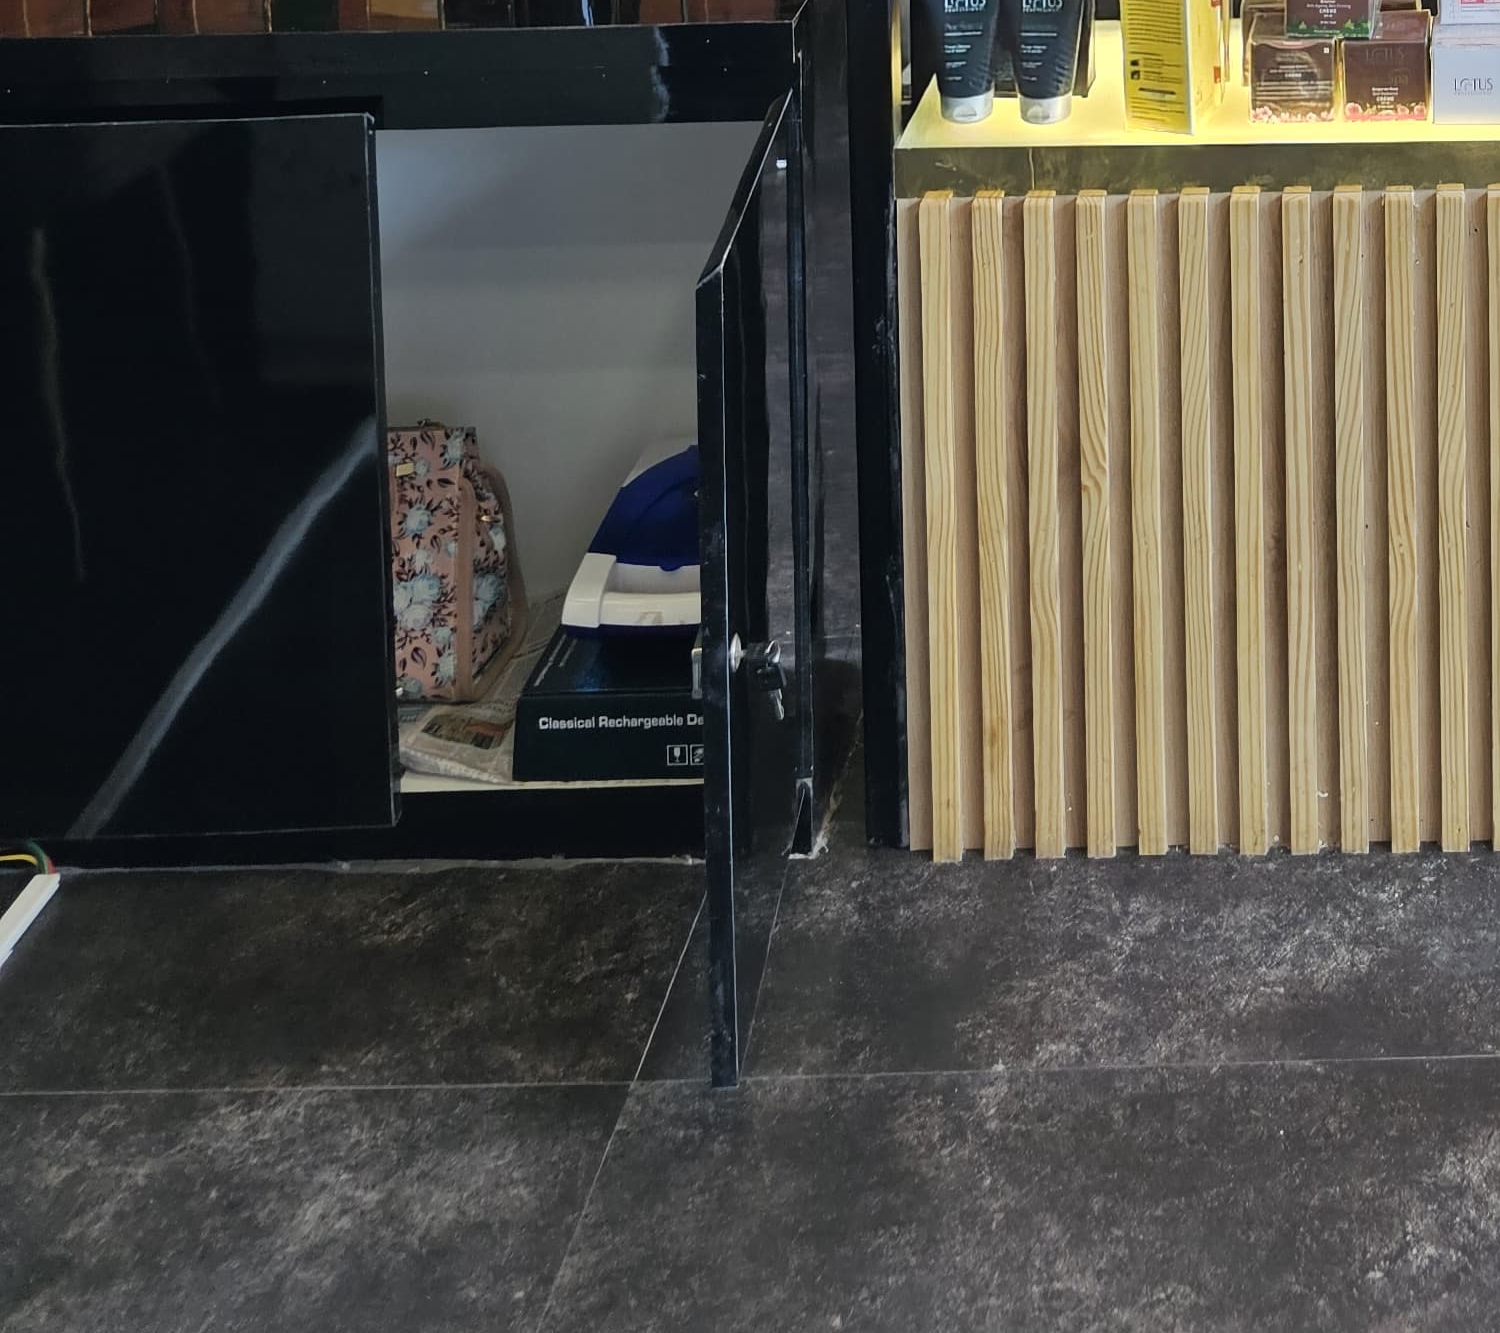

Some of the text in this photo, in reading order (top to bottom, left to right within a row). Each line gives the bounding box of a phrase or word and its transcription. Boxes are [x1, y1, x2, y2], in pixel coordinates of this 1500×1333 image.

[1454, 77, 1493, 92] LOTUS
[538, 716, 595, 729] Classical
[598, 714, 684, 729] Rechargeable
